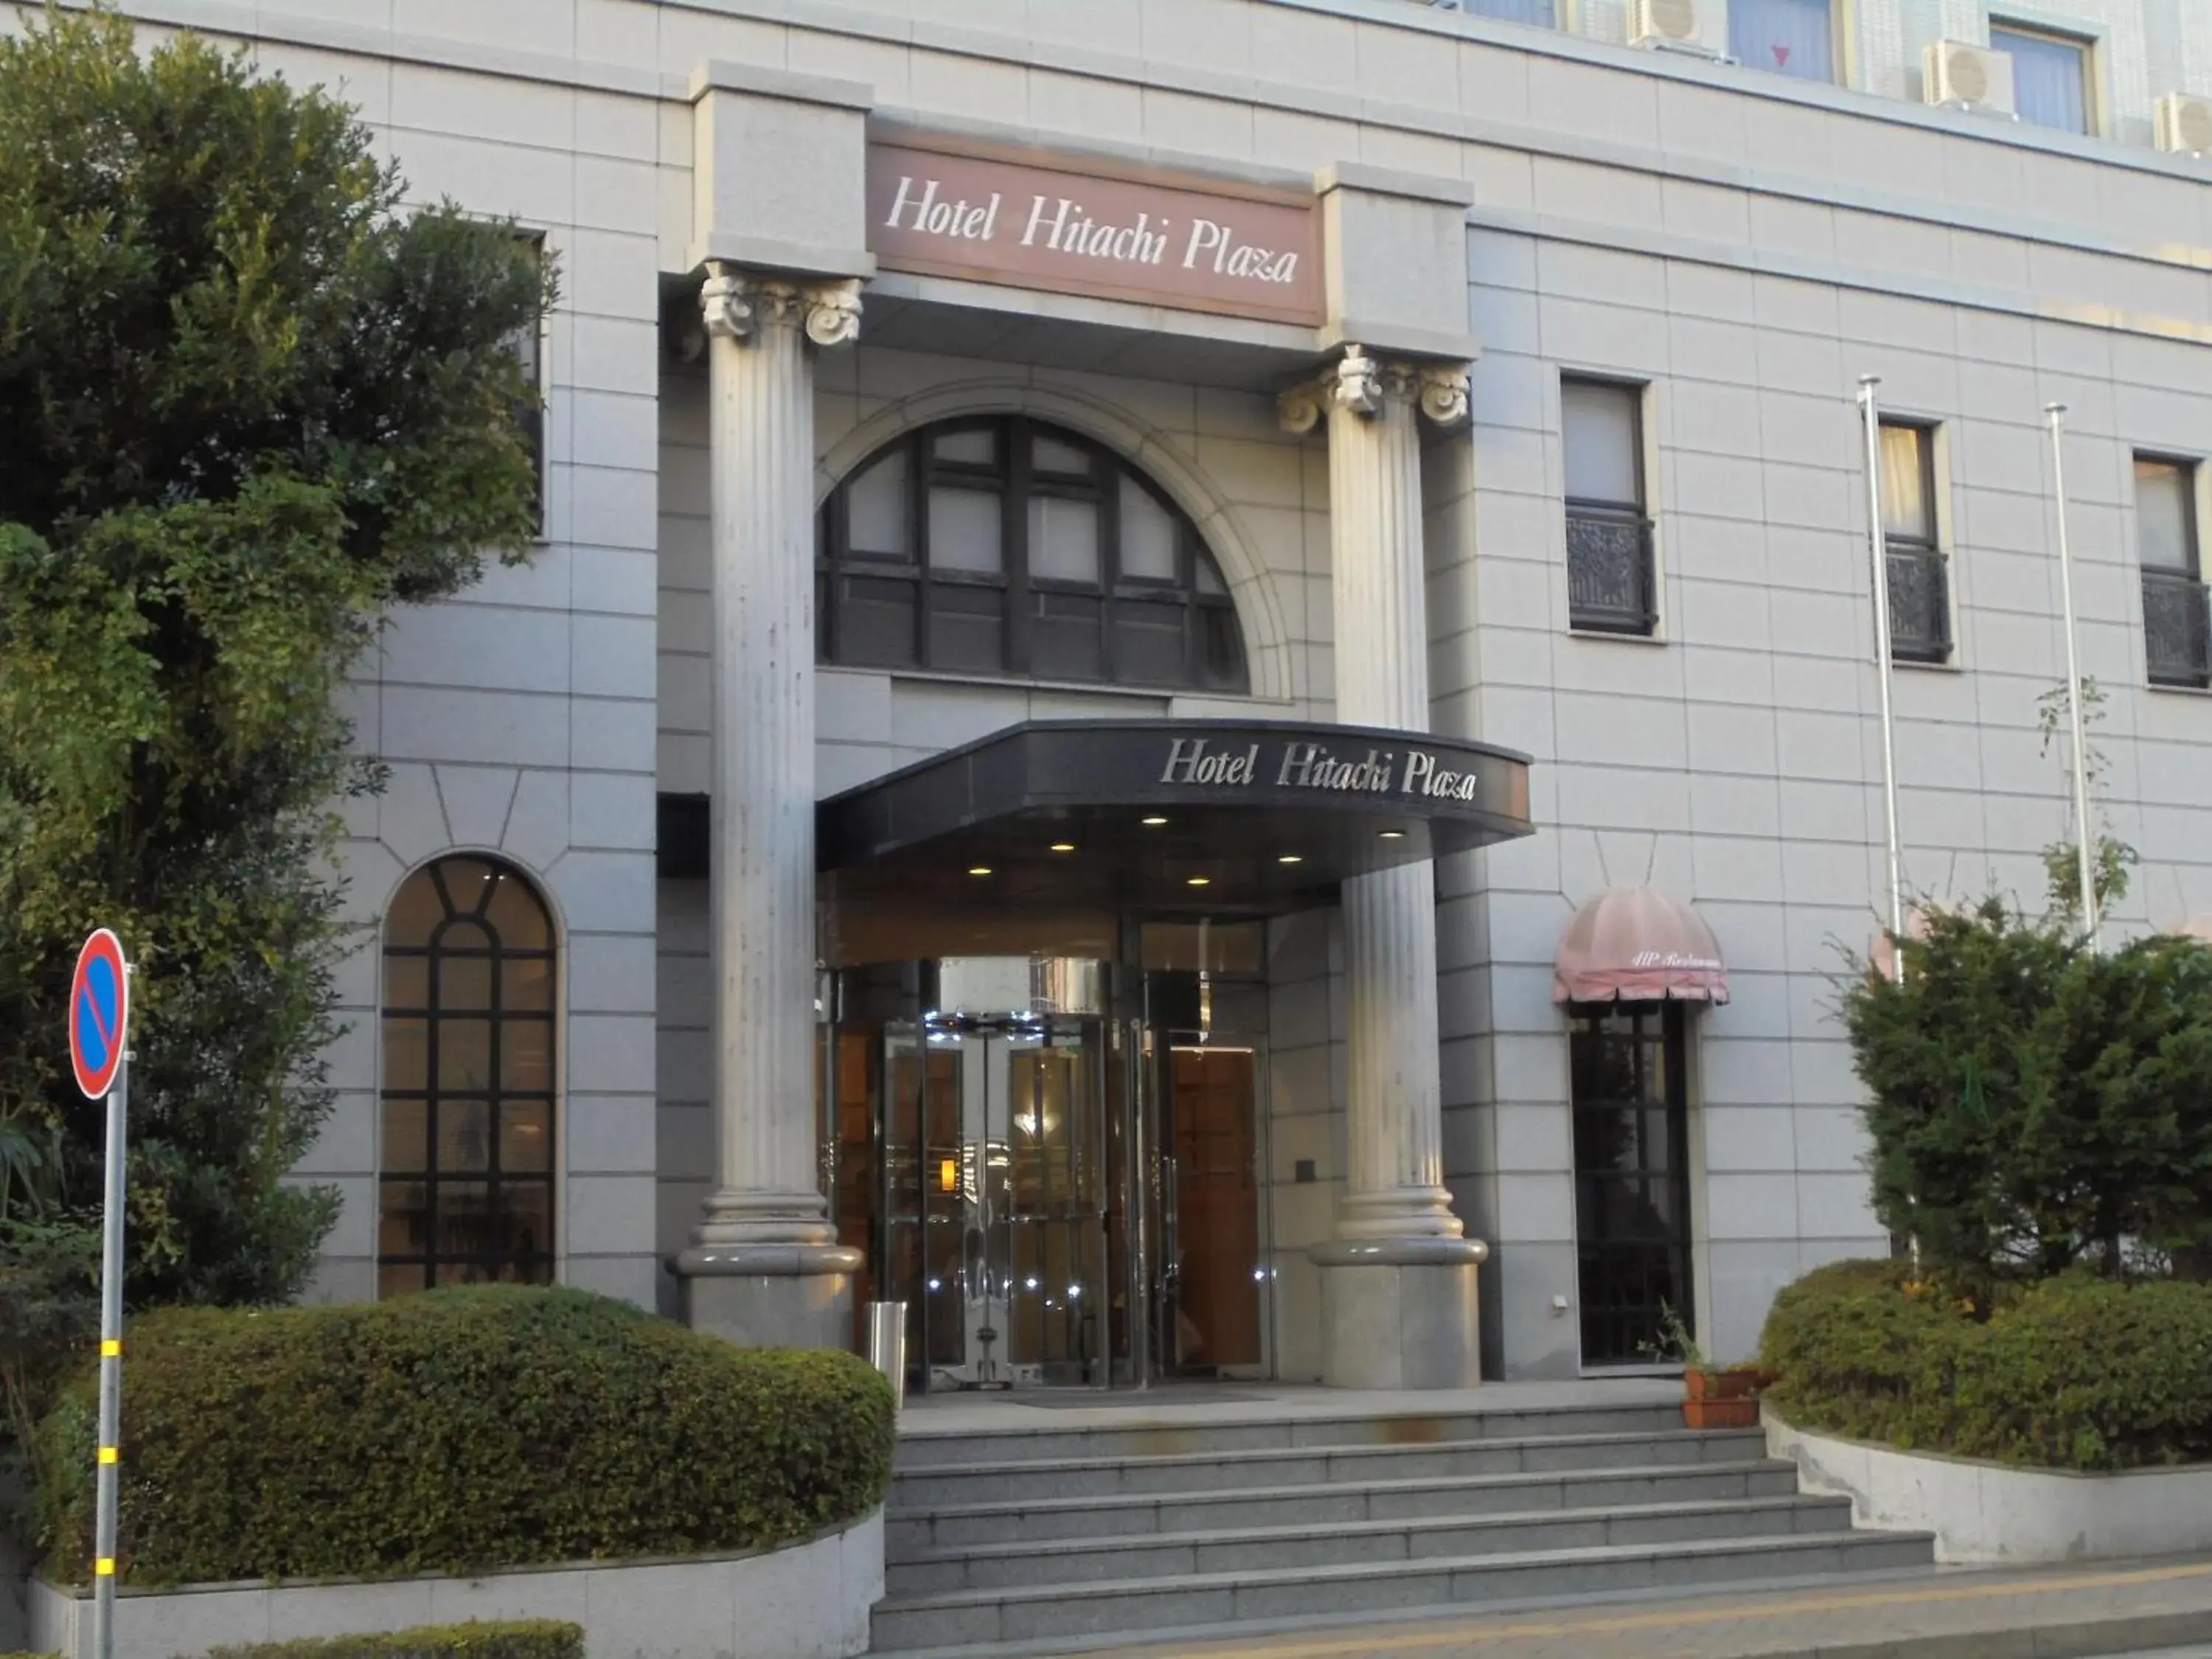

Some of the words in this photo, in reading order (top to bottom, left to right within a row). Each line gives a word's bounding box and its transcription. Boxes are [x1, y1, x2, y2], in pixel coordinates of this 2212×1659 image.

[886, 176, 1001, 240] Hotel
[1020, 195, 1169, 265] Hitachi
[1183, 218, 1298, 282] Plaza
[1160, 738, 1259, 785] Hotel
[1277, 742, 1392, 792] Hitachi
[1401, 751, 1477, 801] Plaza
